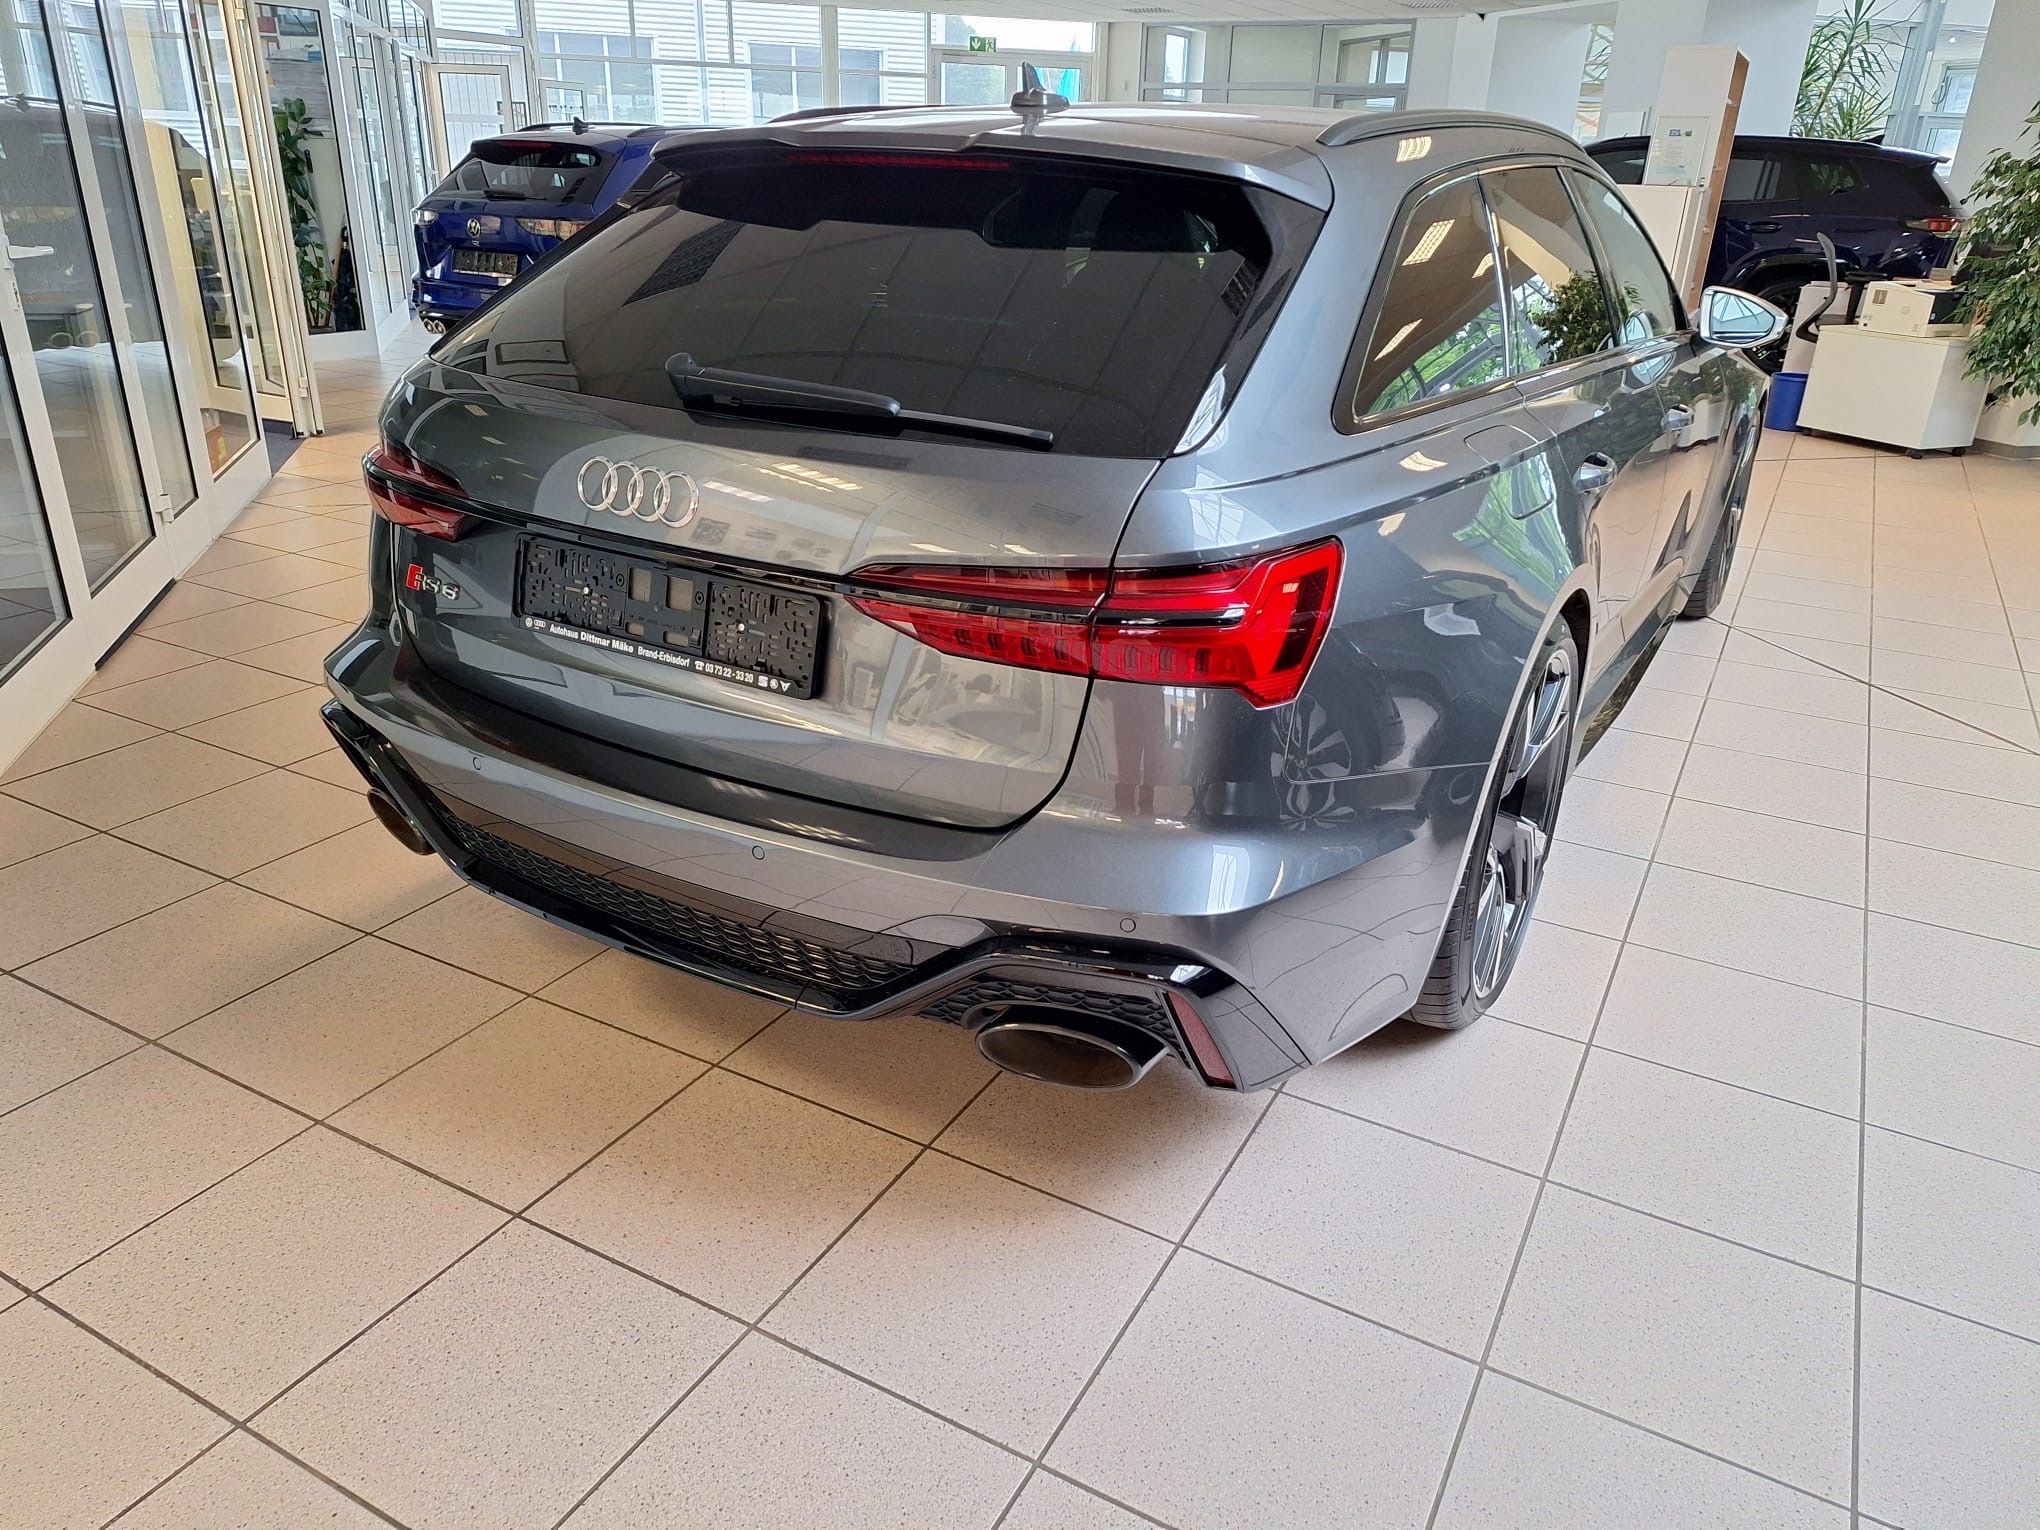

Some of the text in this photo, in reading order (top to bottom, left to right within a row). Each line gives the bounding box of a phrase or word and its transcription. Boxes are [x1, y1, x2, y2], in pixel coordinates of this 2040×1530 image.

[549, 624, 579, 639] Autohaus
[580, 631, 610, 647] Dittmar
[638, 646, 690, 667] Brand-Erbisdorf
